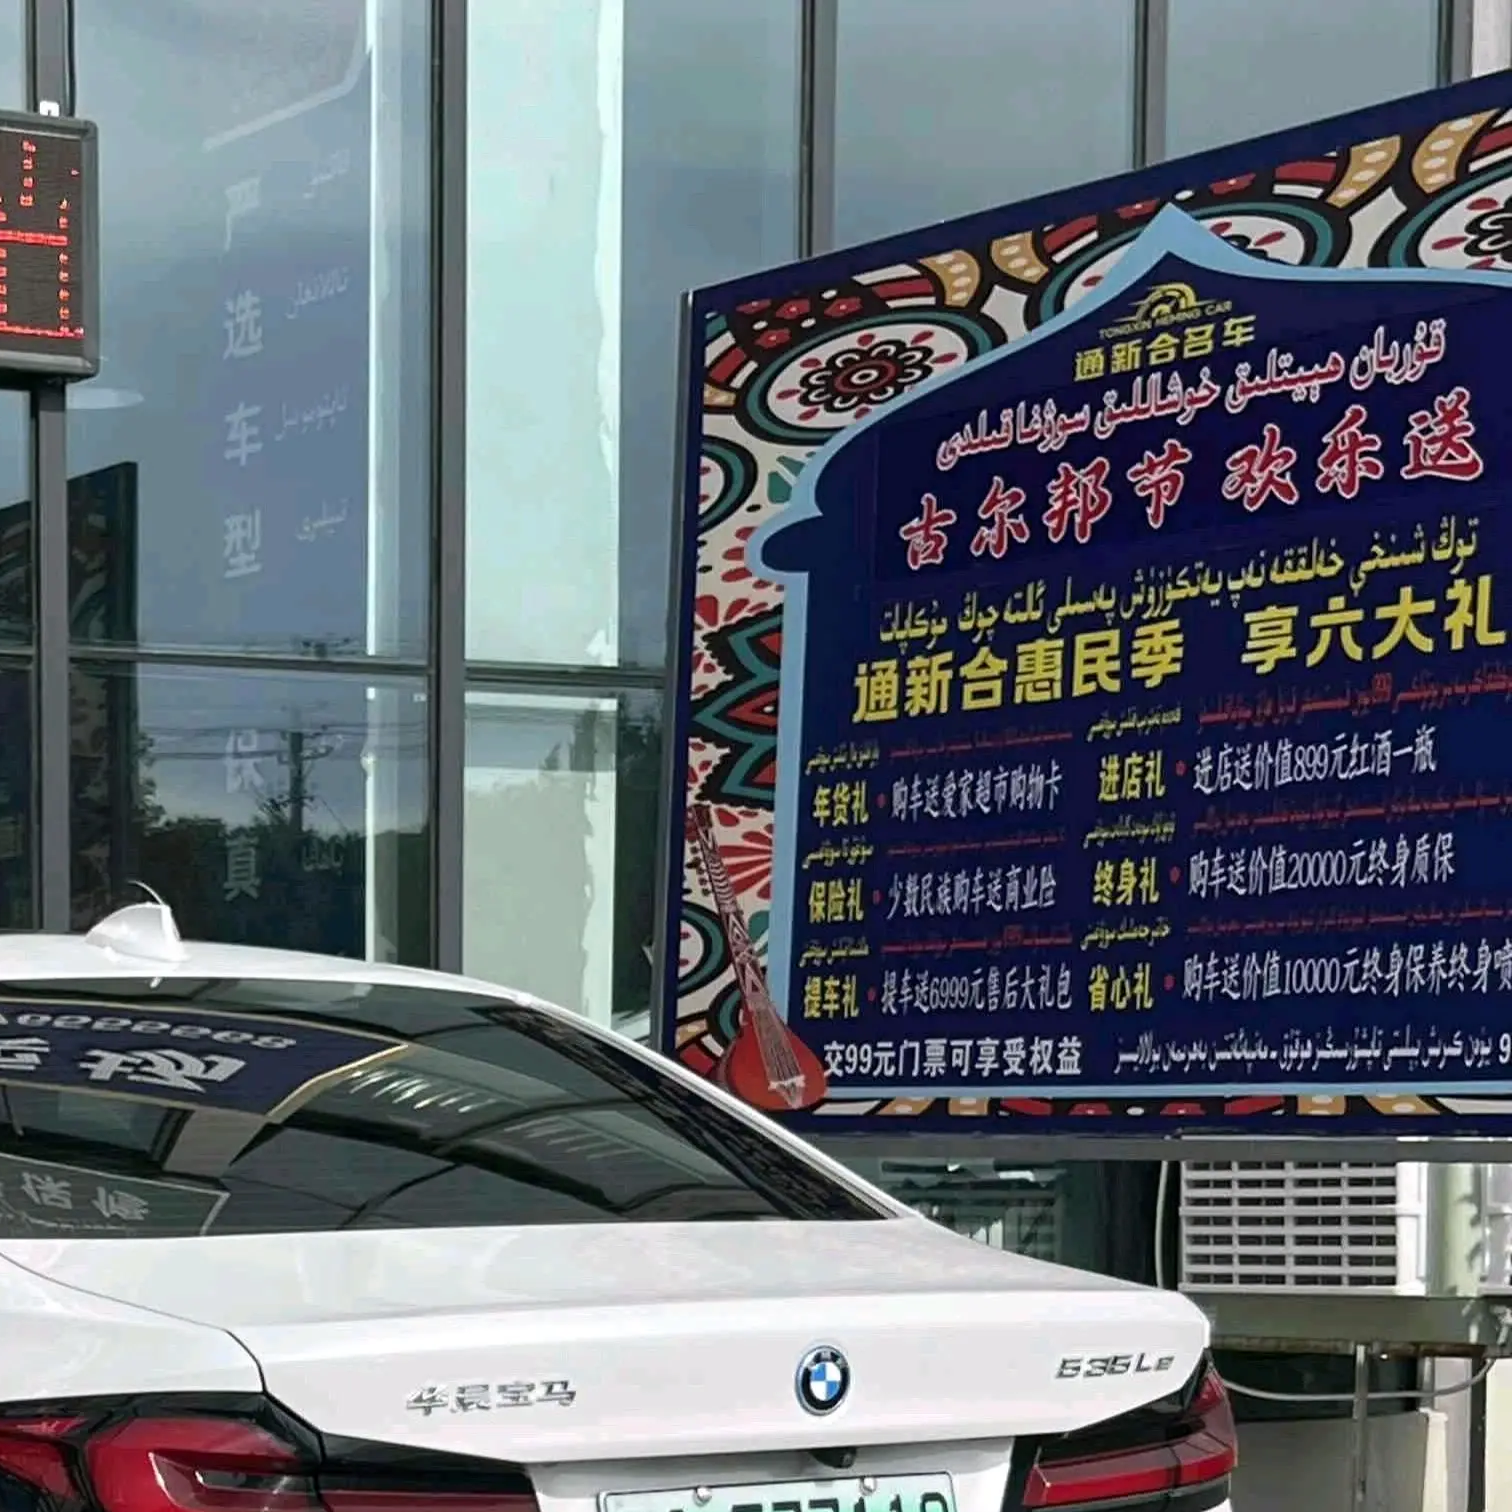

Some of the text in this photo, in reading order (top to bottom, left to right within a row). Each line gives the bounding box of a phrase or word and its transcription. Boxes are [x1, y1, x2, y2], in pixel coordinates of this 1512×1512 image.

[1074, 314, 1257, 383] 通新合名车
[899, 386, 1484, 573] 古尔邦节 欢乐送
[852, 618, 1185, 725] 通新合惠民季
[1242, 574, 1507, 677] 享六大礼
[1098, 749, 1166, 803] 进店礼
[1192, 723, 1437, 796] 进店送价值899元红酒一瓶
[812, 779, 870, 829] 年货礼
[808, 877, 864, 924] 保险礼
[1092, 857, 1161, 906] 终身礼
[803, 974, 860, 1021] 提车礼
[1088, 961, 1154, 1013] 省心礼
[822, 1036, 1083, 1079] 交99元门票可享受权益
[406, 1380, 577, 1417] 华晨宝马
